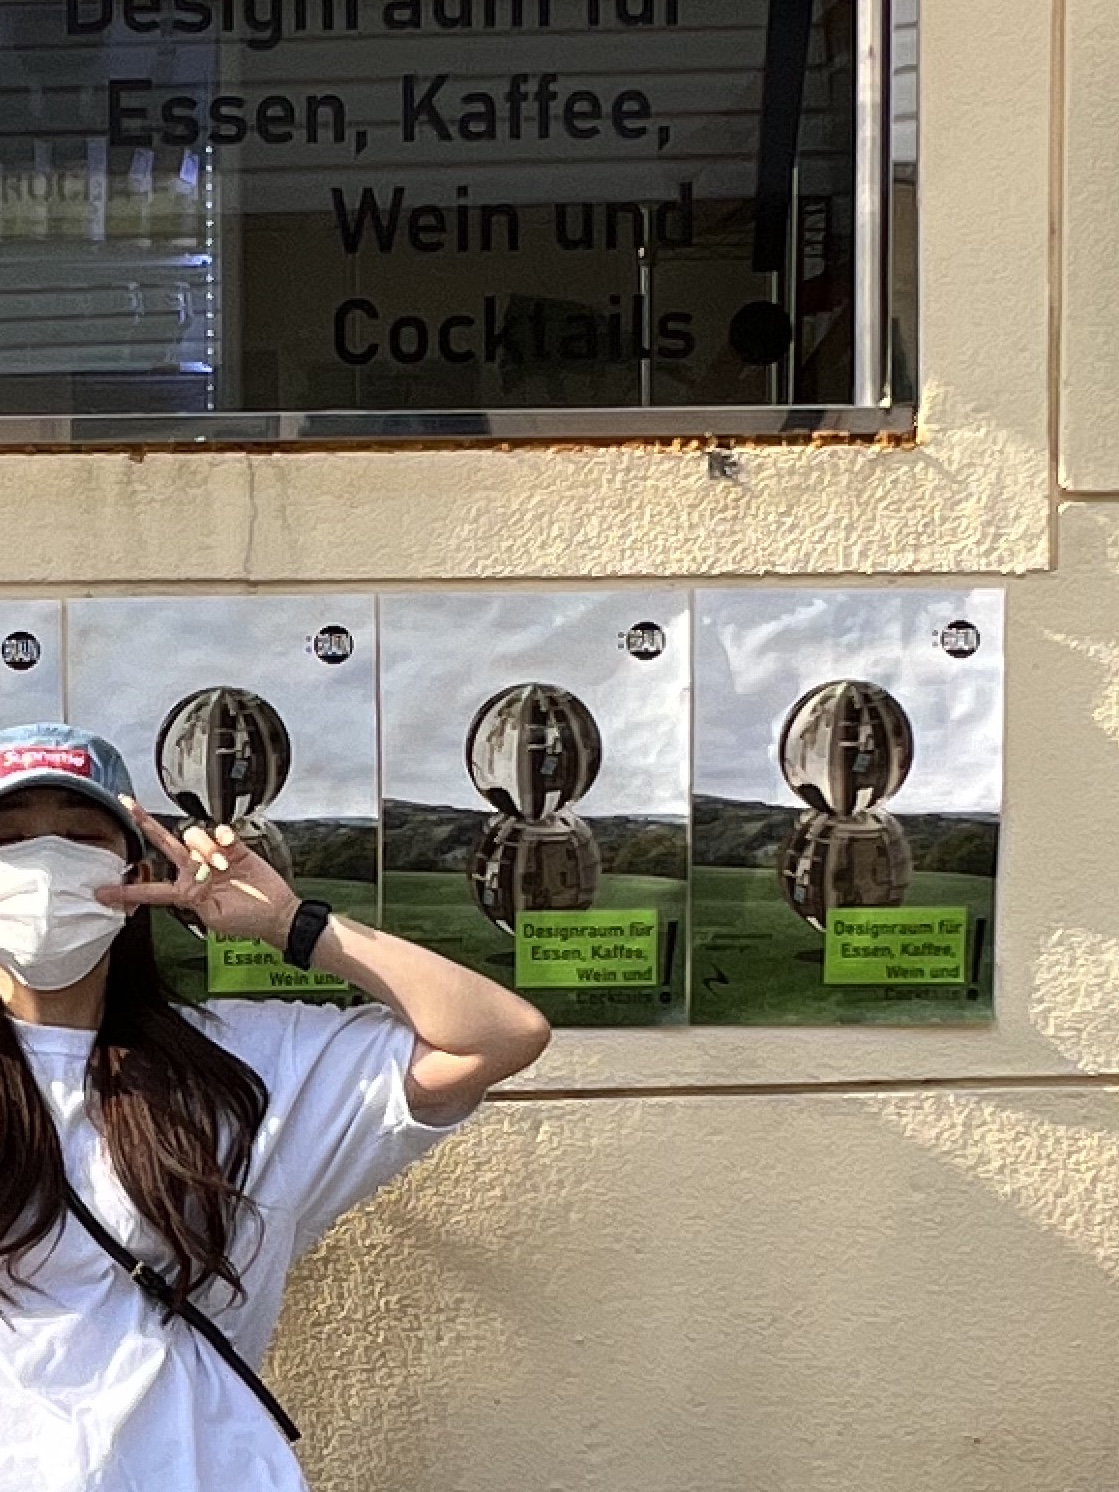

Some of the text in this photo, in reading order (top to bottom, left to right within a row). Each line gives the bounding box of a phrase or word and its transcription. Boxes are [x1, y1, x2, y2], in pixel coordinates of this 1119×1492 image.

[108, 73, 671, 157] Essen, Kaffee,
[332, 181, 694, 254] Wein und
[333, 293, 696, 366] Cocktails
[523, 923, 625, 942] Designraum
[833, 919, 934, 938] Designraum
[270, 971, 309, 987] Wein
[576, 965, 653, 982] Wein und
